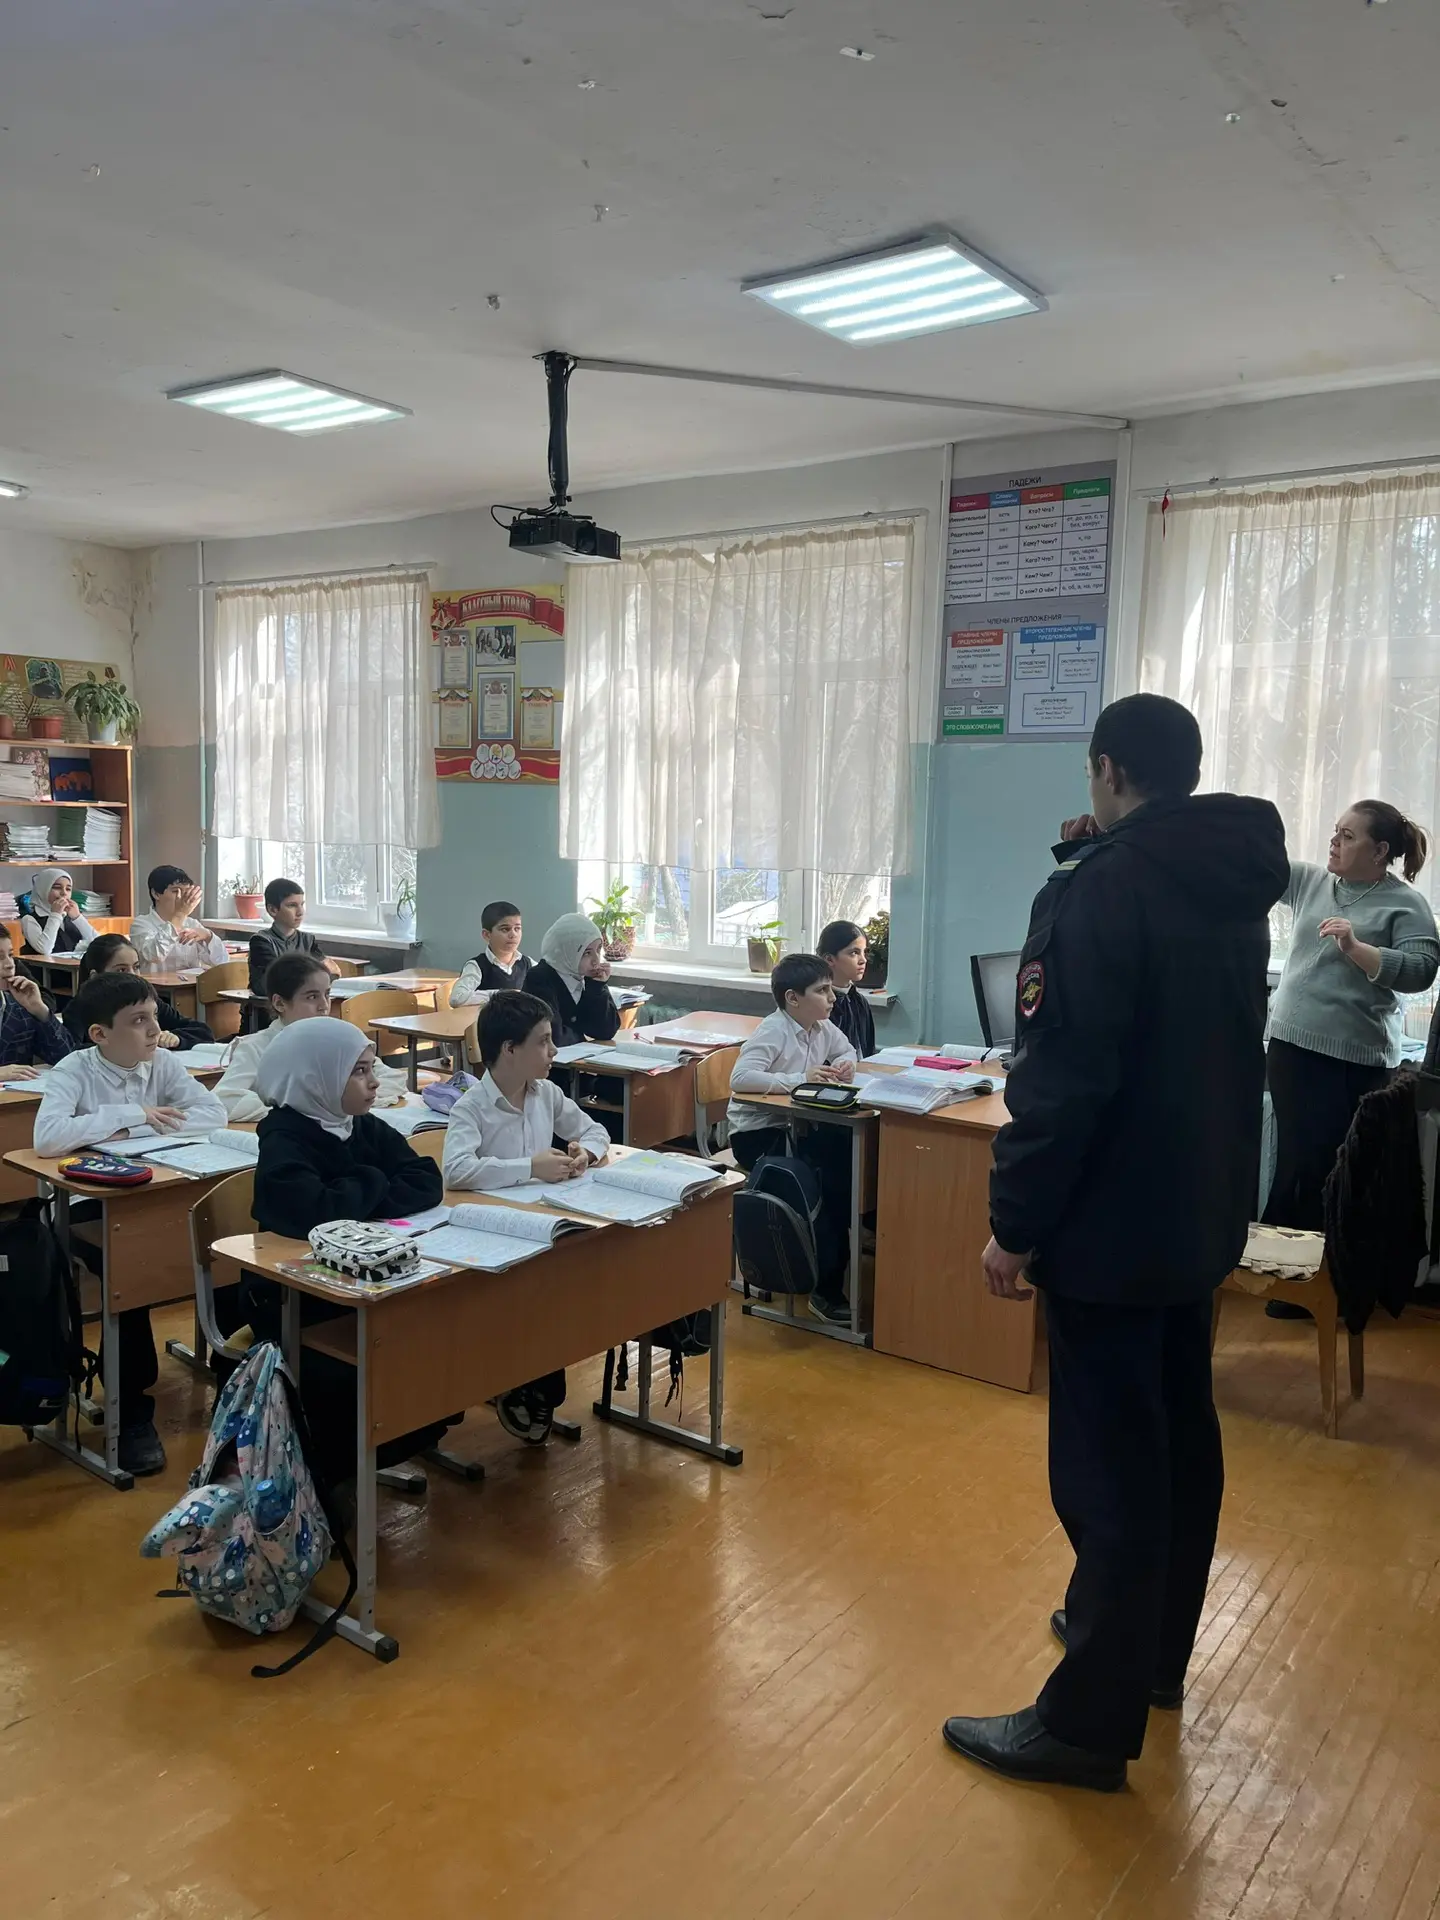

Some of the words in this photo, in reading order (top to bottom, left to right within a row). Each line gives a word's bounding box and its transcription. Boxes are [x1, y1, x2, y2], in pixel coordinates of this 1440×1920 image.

[1009, 477, 1041, 488] ПАДЕЖИ
[462, 596, 501, 614] КЛАССНЫЙ
[503, 596, 531, 611] УГОЛОК
[987, 617, 1010, 625] ЧЛЕНЫ
[1011, 614, 1062, 623] ПРЕДЛОЖЕНИЯ
